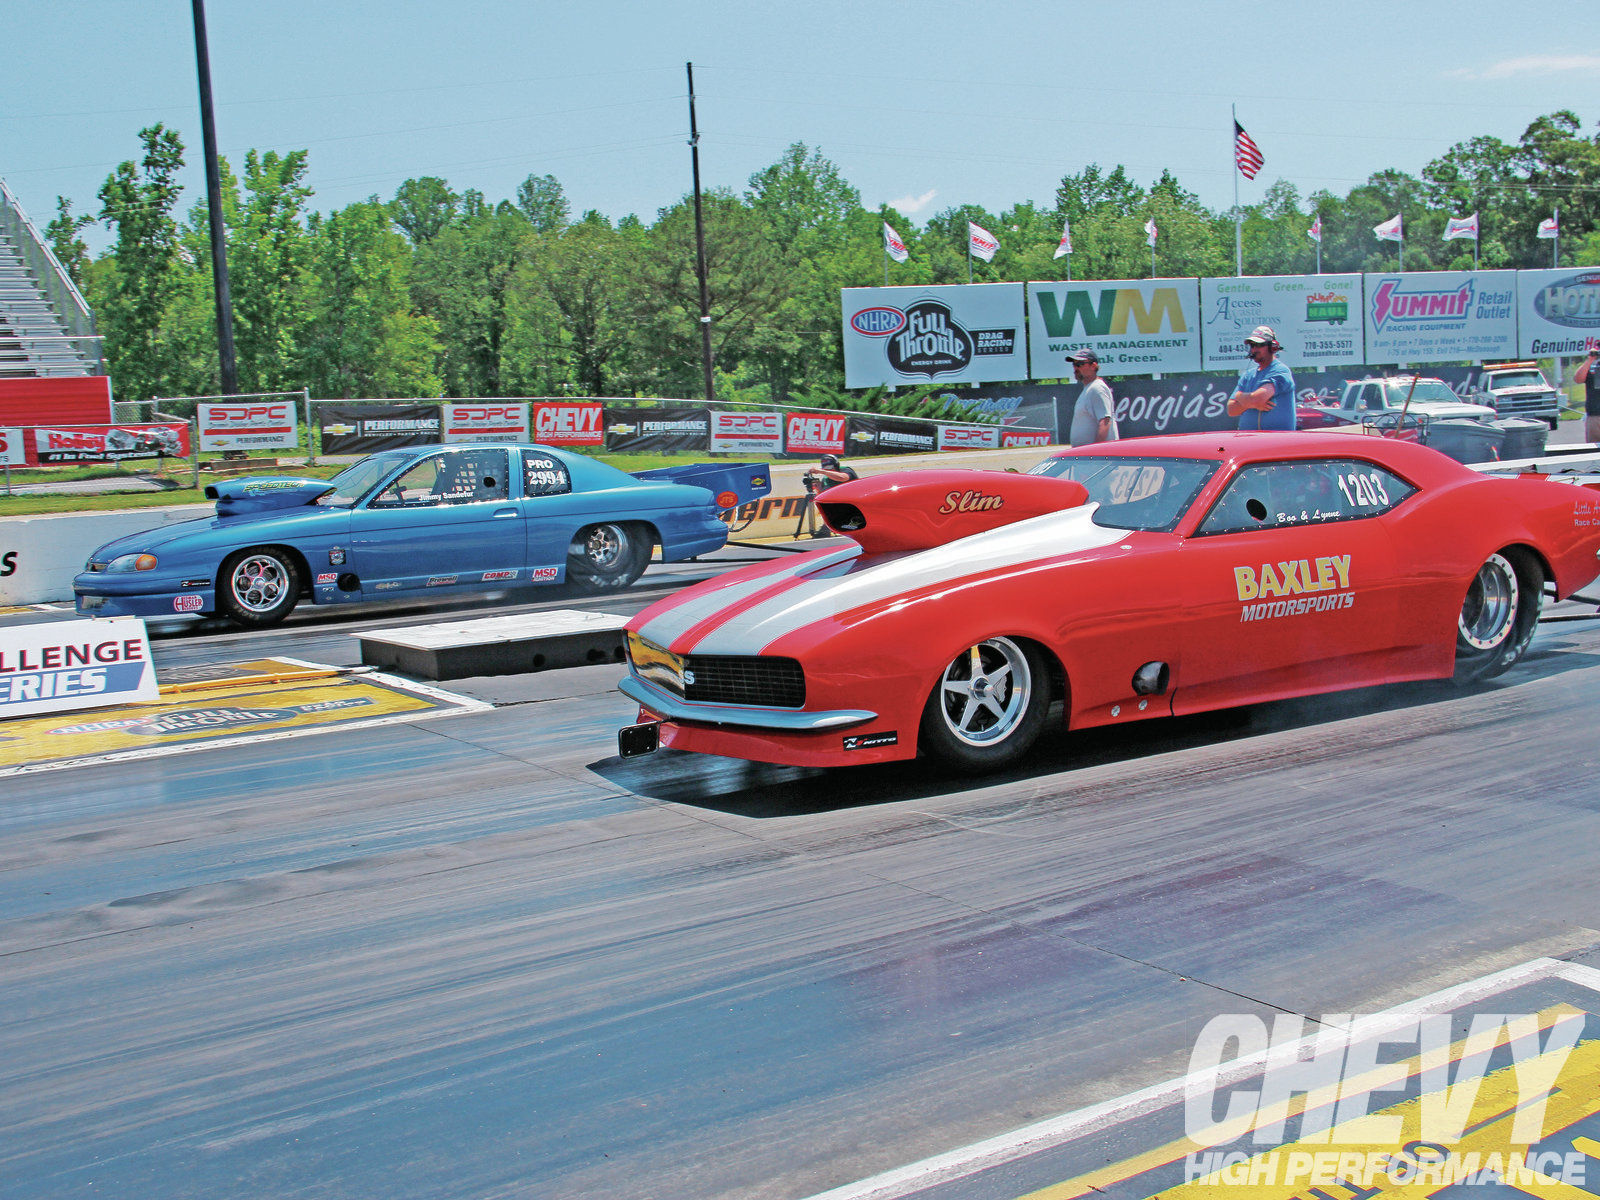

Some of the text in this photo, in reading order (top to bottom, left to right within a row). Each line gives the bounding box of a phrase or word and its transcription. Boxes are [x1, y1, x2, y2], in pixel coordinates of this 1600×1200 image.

[1323, 280, 1353, 290] Gone!
[1477, 291, 1513, 305] Retail
[1036, 288, 1187, 338] WM
[1207, 297, 1262, 325] Access
[1308, 306, 1347, 318] HAUL
[1476, 306, 1511, 319] Outlet
[858, 311, 899, 331] NHRA
[1386, 322, 1467, 332] RACING EQUIPMENT
[978, 332, 1004, 340] DRAG
[977, 338, 1013, 348] RACING
[1048, 339, 1188, 352] WASTE MANAGEMENT
[209, 405, 287, 421] SDPC
[1111, 383, 1228, 431] eorgia's
[453, 407, 521, 421] SDPC
[536, 407, 602, 432] CHEVY
[364, 419, 440, 431] PERFORMANCE
[642, 420, 708, 431] PERFORMANCE
[719, 415, 777, 428] SDPC
[788, 417, 844, 441] CHEVY
[944, 429, 993, 442] SDPC
[880, 431, 934, 445] PERFORMANCE
[106, 450, 160, 461] Systems
[526, 459, 554, 469] PRO
[527, 470, 566, 485] 2994
[418, 490, 474, 502] Jimmy Sandefur
[1337, 473, 1390, 507] 1203
[938, 489, 1005, 516] Slim
[1276, 507, 1341, 524] Boo & Lynne
[1574, 518, 1591, 527] Race
[319, 573, 337, 581] MSD
[484, 571, 510, 579] COMP
[535, 568, 557, 578] MSD
[1233, 554, 1353, 602] BAXLEY
[1240, 591, 1356, 623] MOTORSPORTS
